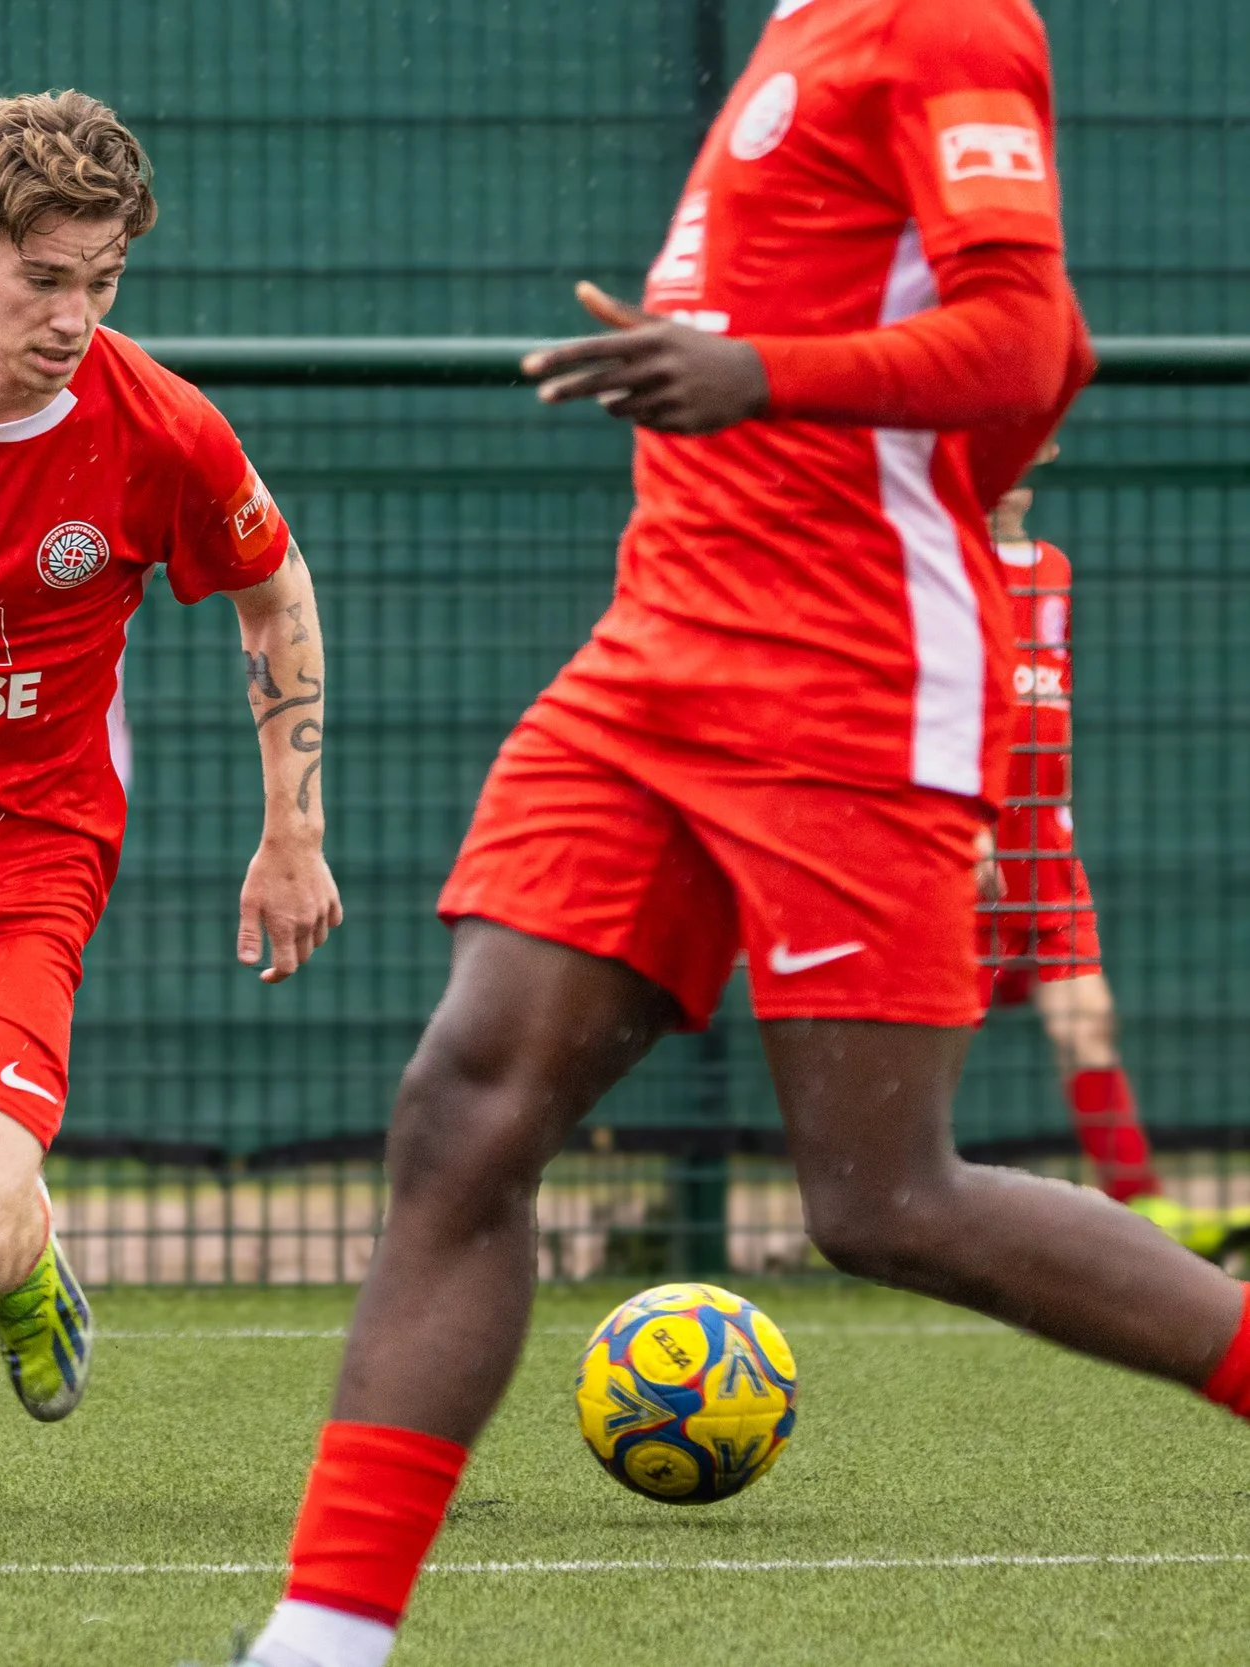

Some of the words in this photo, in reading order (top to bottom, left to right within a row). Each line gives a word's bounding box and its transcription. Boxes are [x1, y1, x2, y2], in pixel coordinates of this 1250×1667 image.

[44, 529, 64, 548] QUORN
[66, 526, 98, 540] FOOTBALL
[652, 1328, 692, 1370] DELTA
